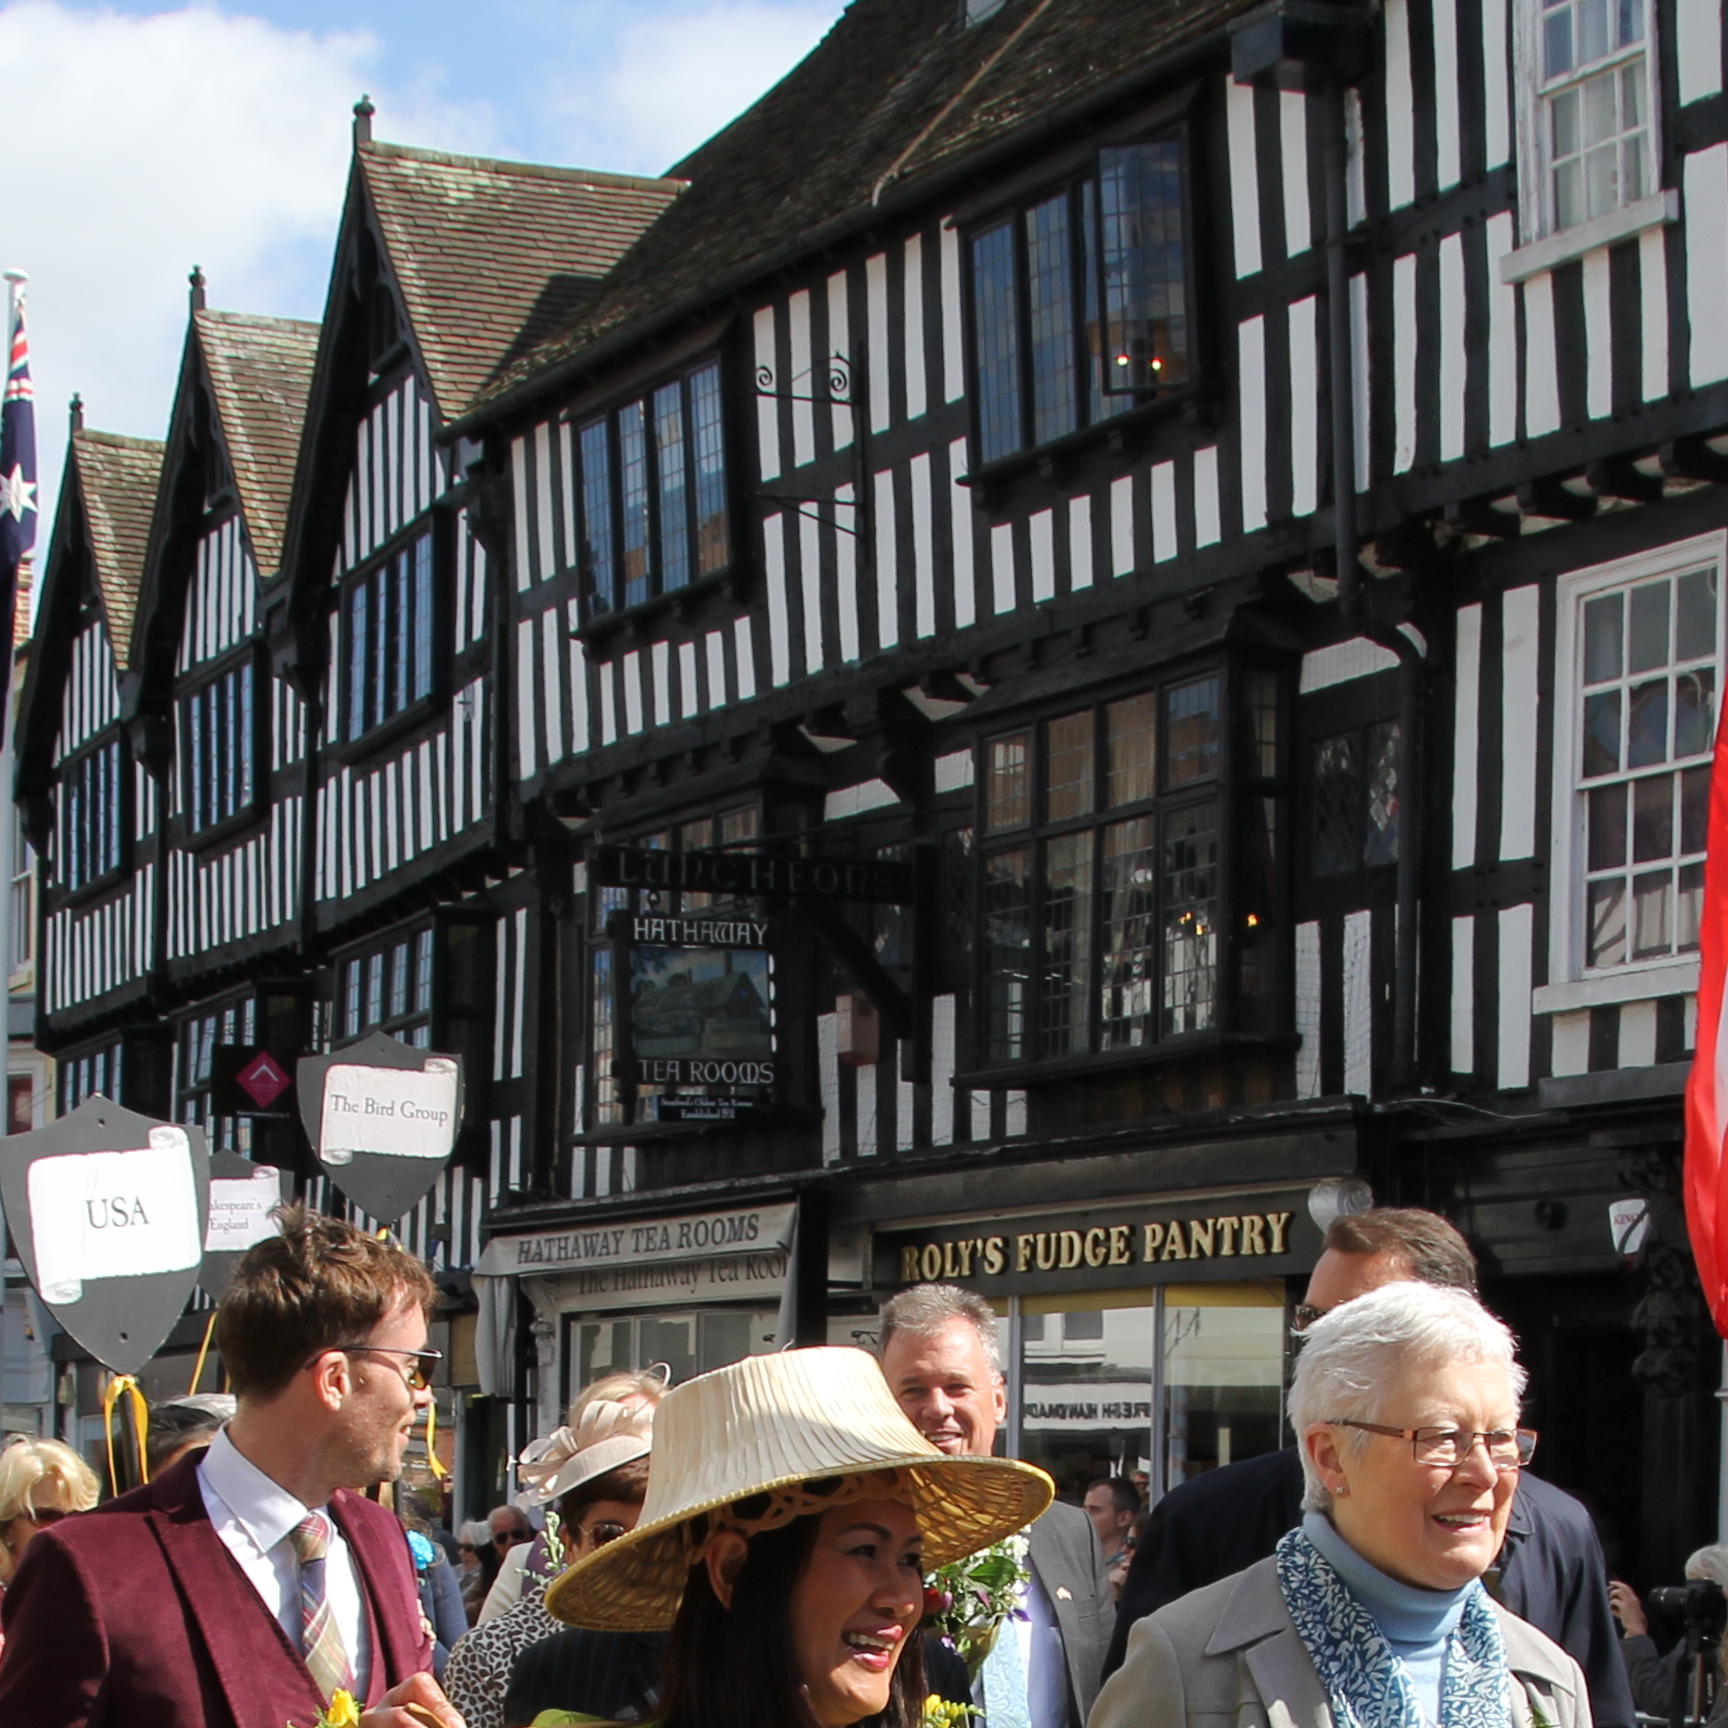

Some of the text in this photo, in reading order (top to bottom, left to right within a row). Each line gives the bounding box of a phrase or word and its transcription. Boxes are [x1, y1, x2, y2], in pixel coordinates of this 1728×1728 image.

[633, 917, 768, 946] HATHAWAY
[638, 1059, 775, 1085] TEA ROOMS
[330, 1093, 449, 1128] The Bird Group
[86, 1195, 150, 1230] USA
[209, 1217, 249, 1235] England
[517, 1212, 761, 1265] HATHAWAY TEA ROOMS
[900, 1211, 1292, 1283] ROLY'S FUDGE PANTRY
[612, 1257, 702, 1294] Hathaway
[708, 1256, 740, 1283] Tea
